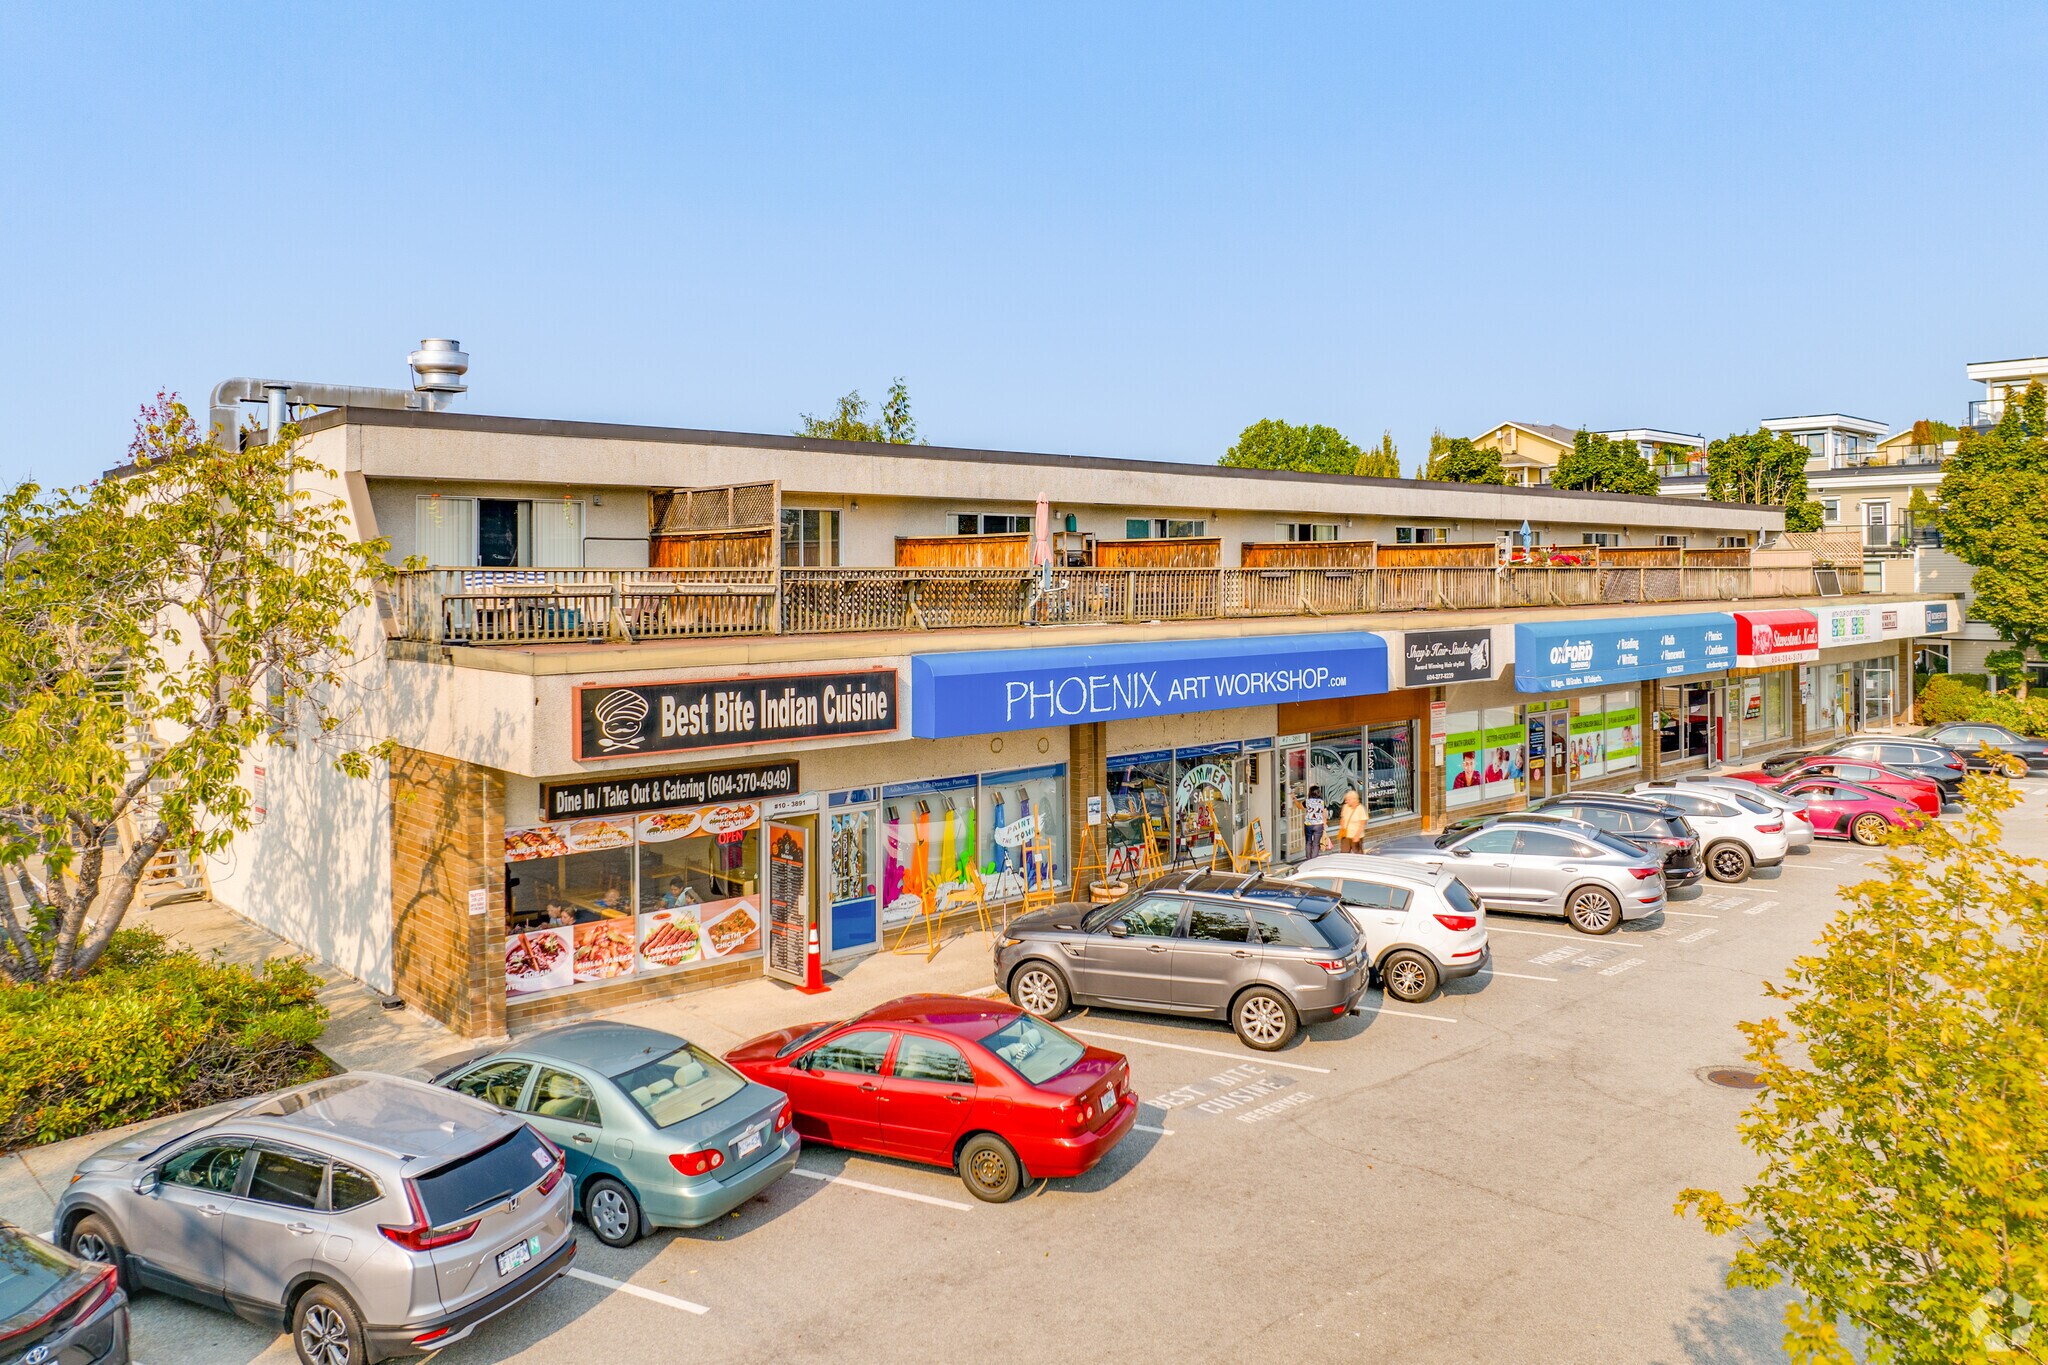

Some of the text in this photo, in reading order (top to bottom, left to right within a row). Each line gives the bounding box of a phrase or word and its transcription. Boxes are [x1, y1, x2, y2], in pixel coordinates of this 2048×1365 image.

[1664, 634, 1675, 646] Math
[1708, 630, 1723, 641] Phonics
[1802, 628, 1818, 645] Nails
[1406, 641, 1471, 662] Shay's Hair Studio
[1550, 639, 1593, 664] OXFORD
[1621, 637, 1640, 651] Reading
[1708, 644, 1729, 656] Confidence
[1621, 653, 1639, 666] Writing
[1664, 648, 1686, 660] Homework
[1414, 663, 1428, 671] Award
[1428, 661, 1444, 670] Winning
[1444, 660, 1453, 668] Hair
[1006, 670, 1162, 722] PHOENIX
[1168, 675, 1211, 702] ART
[661, 682, 888, 738] Best Bite Indian Cuisine
[1367, 742, 1375, 780] SHAY'S
[1182, 767, 1227, 793] SUMMER
[556, 790, 583, 814] Dine
[584, 789, 597, 810] In
[603, 784, 629, 808] Take
[631, 783, 650, 805] Out
[652, 782, 661, 802] &
[663, 779, 706, 802] Catering
[706, 766, 791, 799] (604-370-4949)
[1193, 789, 1215, 803] SALE
[1006, 817, 1031, 835] PAINT
[717, 830, 744, 845] OPEN
[506, 843, 561, 855] PANEER TIKKA
[715, 938, 745, 949] CHICKEN
[720, 931, 742, 941] METHI
[666, 940, 698, 951] CHICKEN
[1144, 1084, 1207, 1111] BEST
[1209, 1063, 1266, 1087] BITE
[1197, 1078, 1286, 1115] CUISINE
[1236, 1091, 1315, 1124] RESERVED
